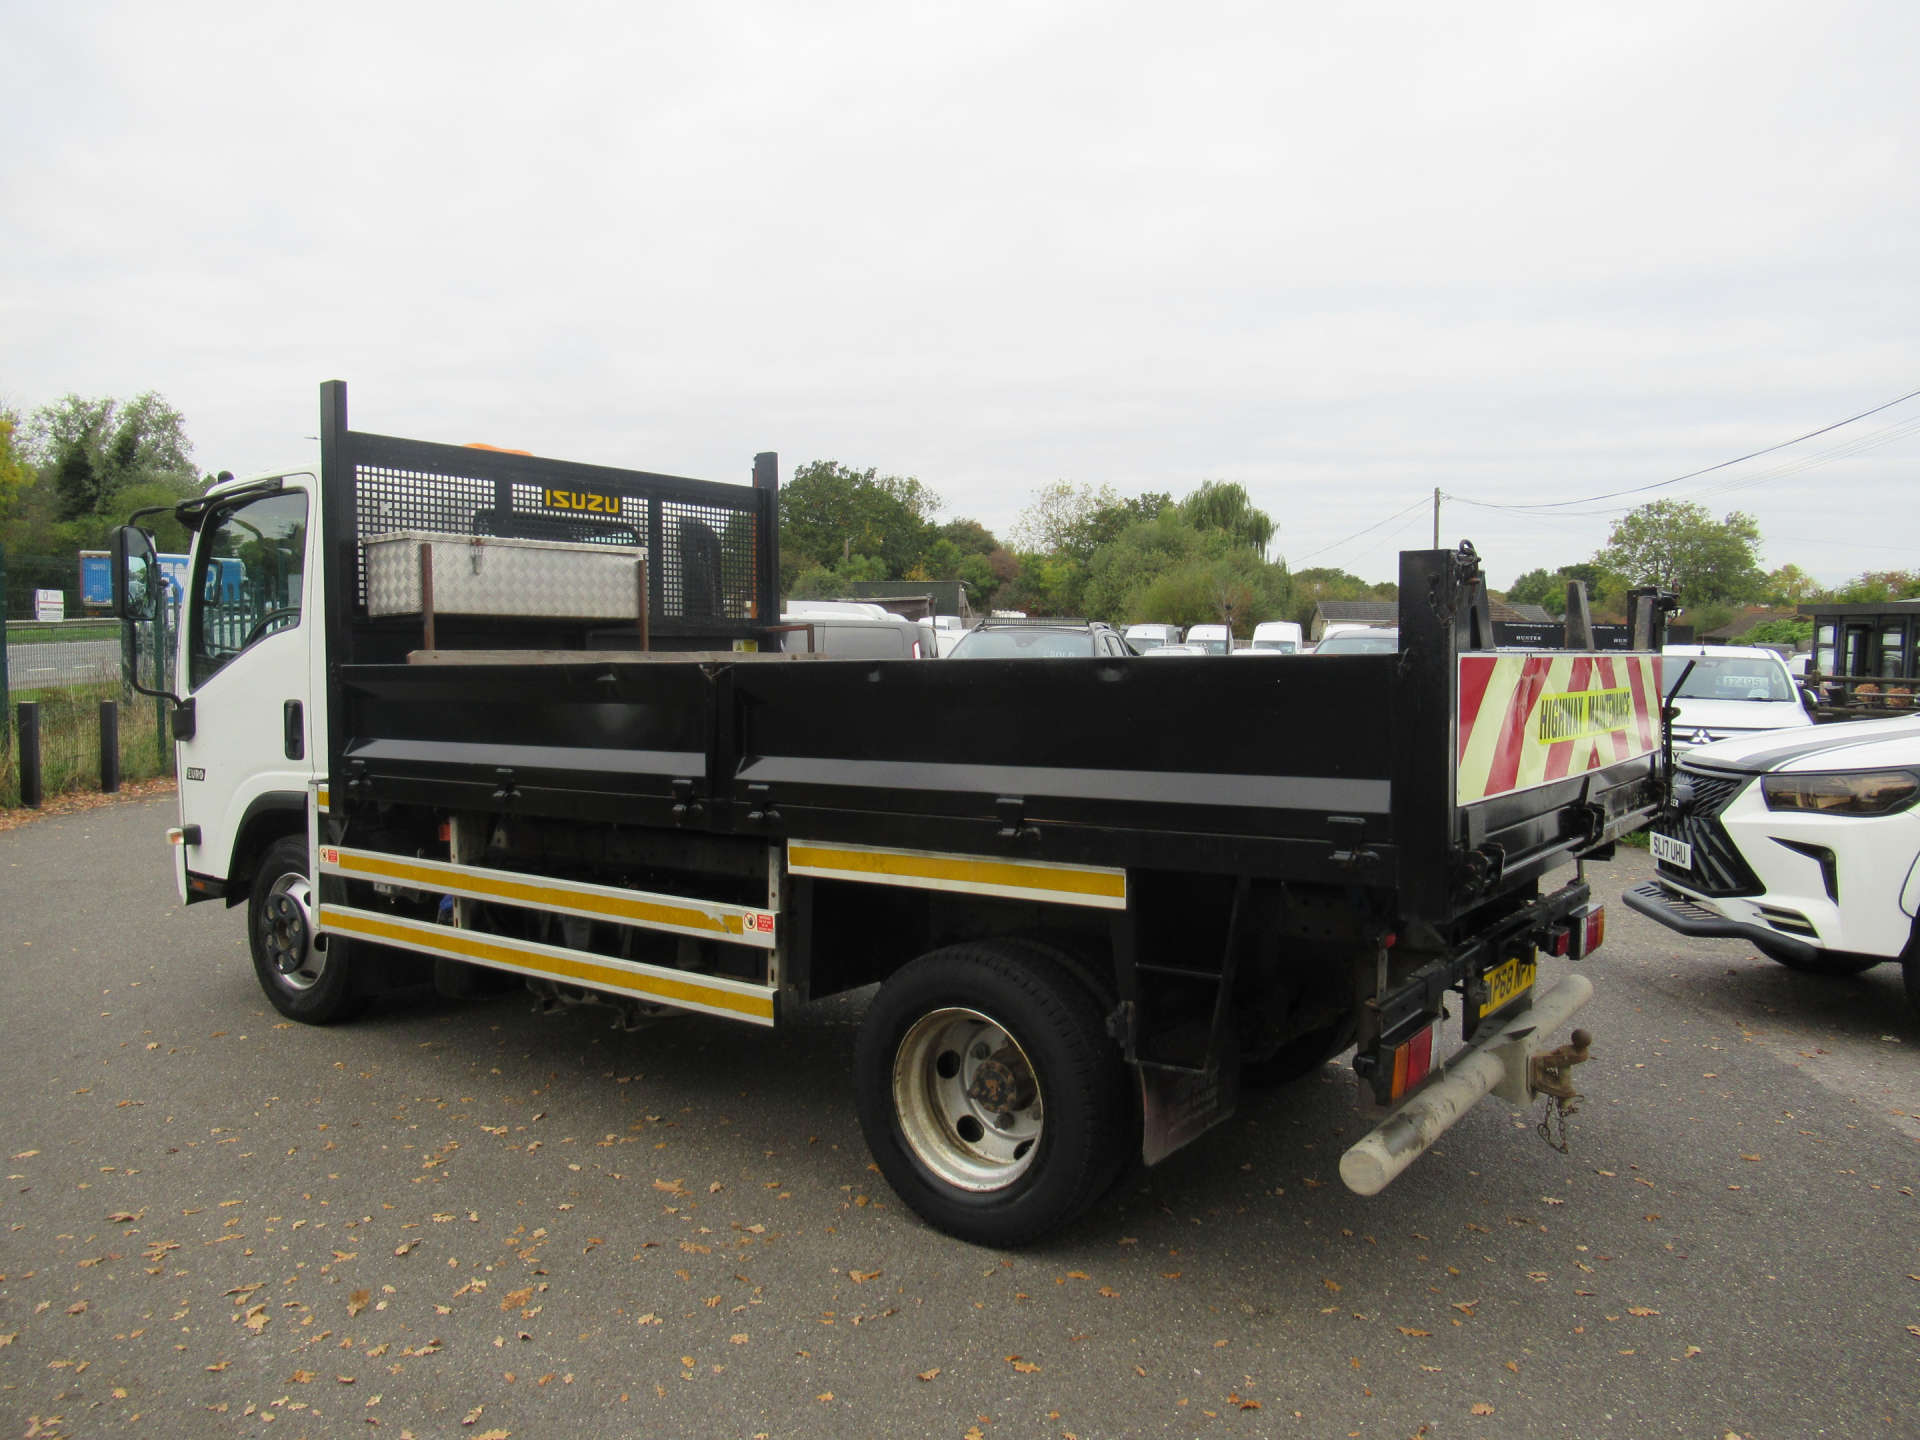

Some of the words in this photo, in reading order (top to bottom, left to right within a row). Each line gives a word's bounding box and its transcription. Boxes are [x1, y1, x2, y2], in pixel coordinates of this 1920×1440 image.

[545, 489, 619, 513] ISUZU
[1540, 696, 1584, 740] HIGHWAY
[1653, 836, 1669, 858] SL17
[1671, 845, 1686, 864] UHU
